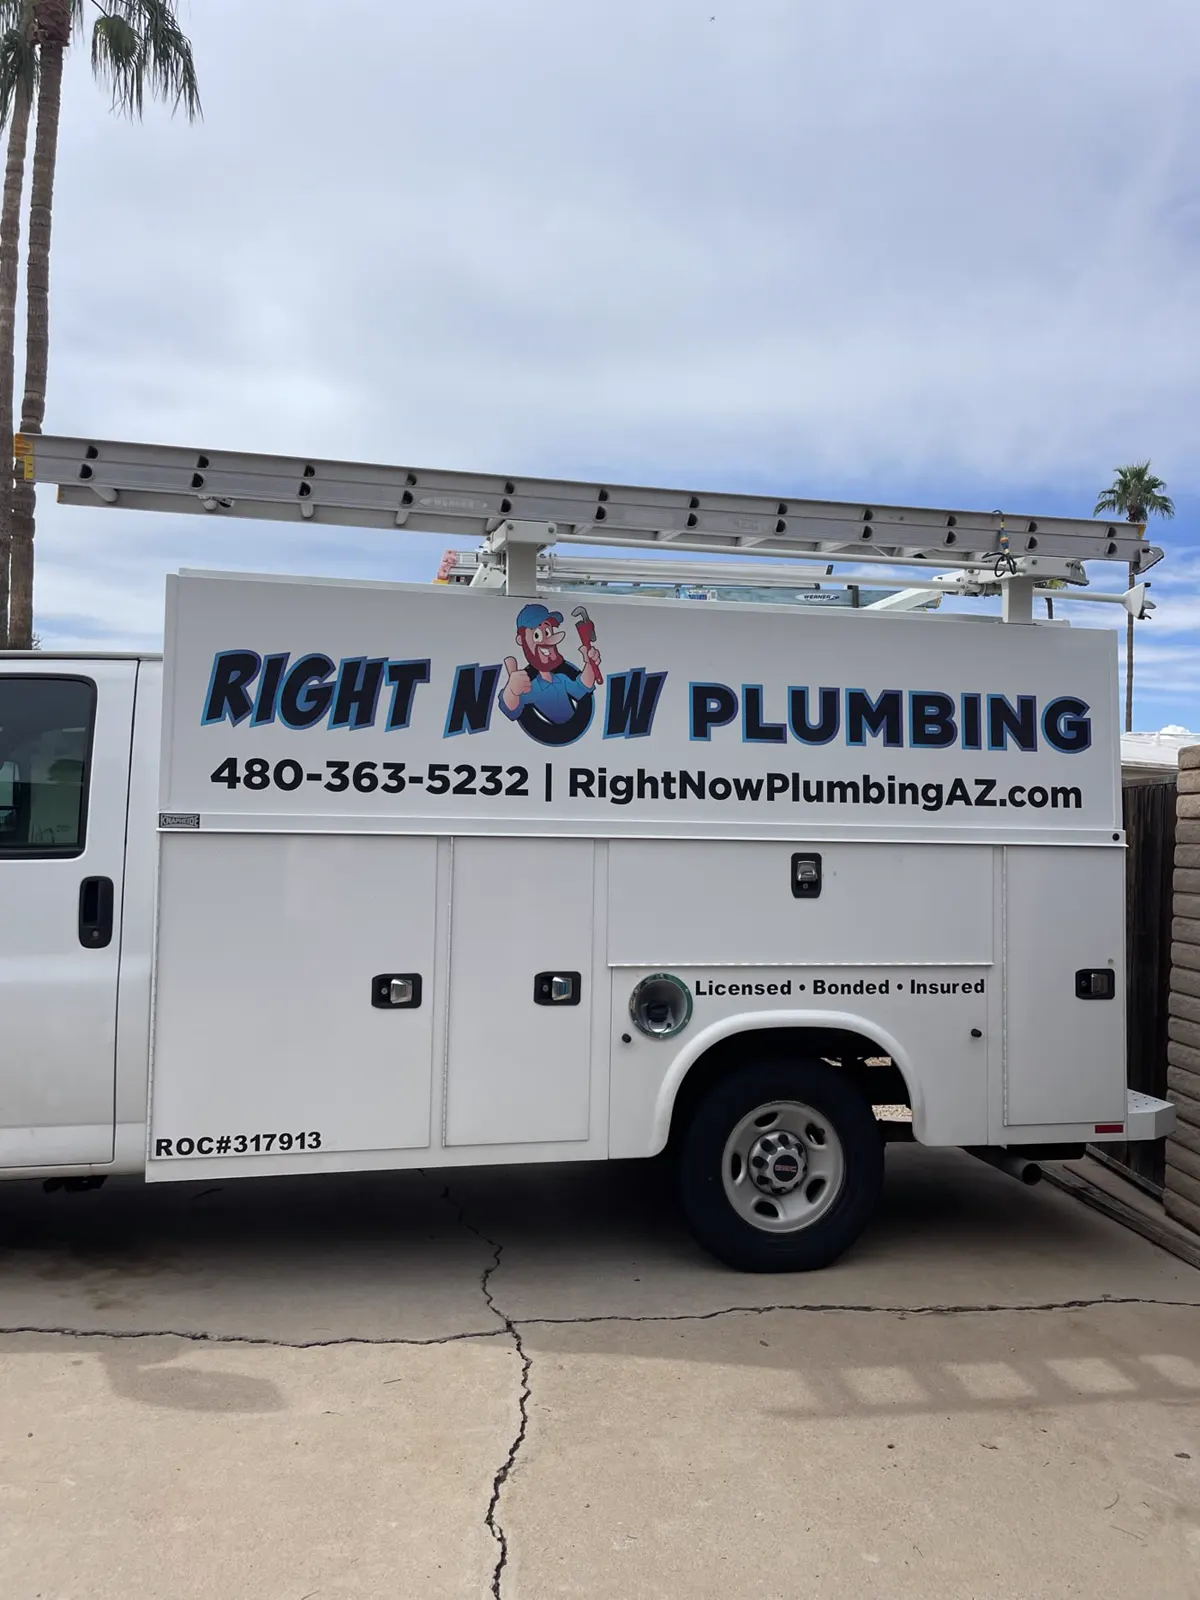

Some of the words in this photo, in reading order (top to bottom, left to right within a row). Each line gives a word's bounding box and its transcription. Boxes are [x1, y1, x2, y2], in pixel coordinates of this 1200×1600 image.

[201, 648, 431, 732] RIGHT
[443, 661, 669, 748] NOW
[689, 681, 1092, 754] PLUMBING
[211, 757, 529, 797] 480-363-5232
[569, 767, 1082, 812] RightNowPlumbingAZ.com
[695, 980, 792, 996] Licensed
[813, 979, 890, 995] Bonded
[910, 978, 985, 995] Insured
[155, 1131, 322, 1156] ROC#317913
[774, 1164, 798, 1173] GMC
